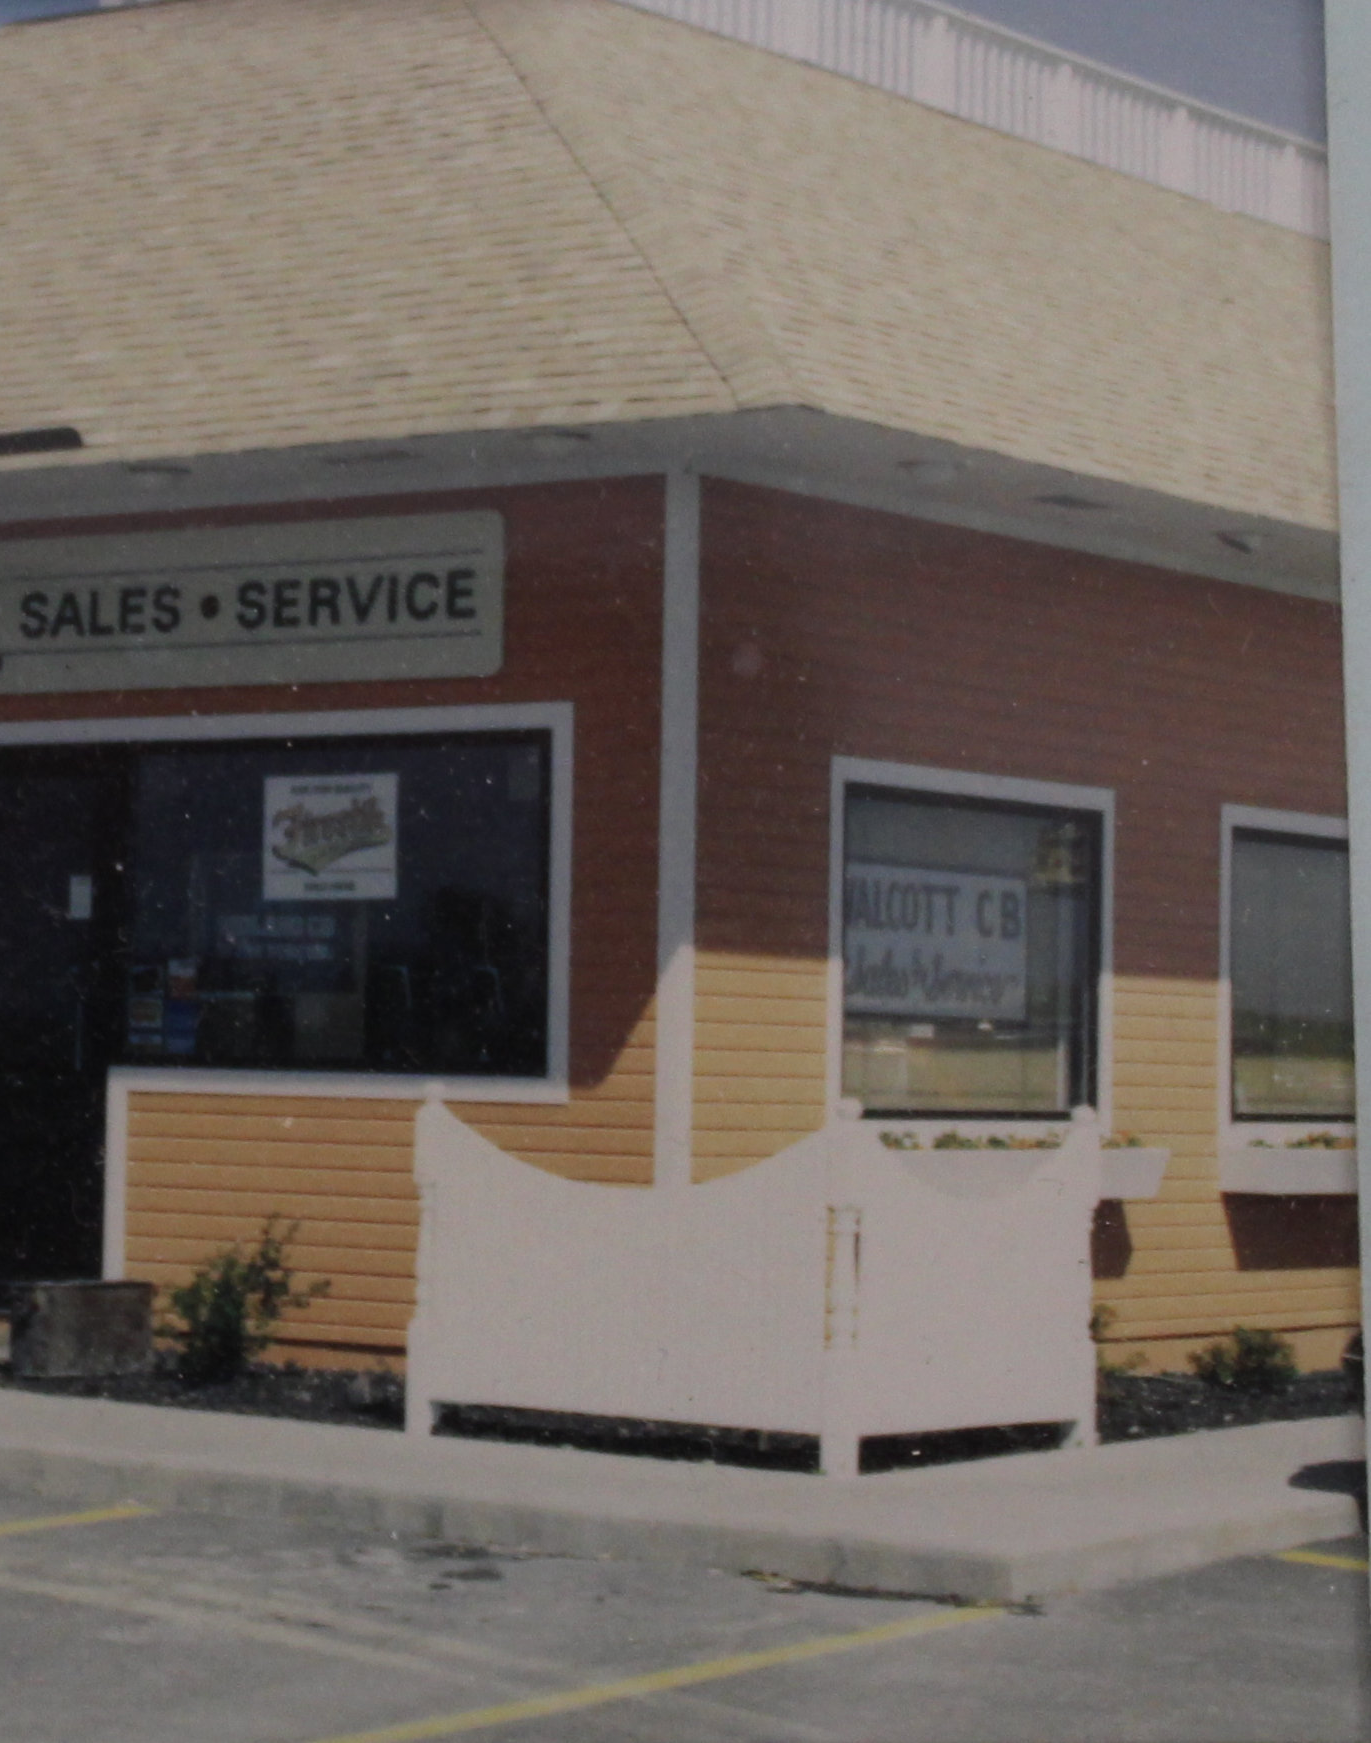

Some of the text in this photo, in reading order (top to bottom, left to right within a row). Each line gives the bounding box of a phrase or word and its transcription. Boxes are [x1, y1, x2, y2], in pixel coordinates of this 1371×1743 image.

[20, 587, 182, 640] SALES
[234, 567, 477, 630] SERVICE
[844, 880, 1022, 940] ALCOTT CB
